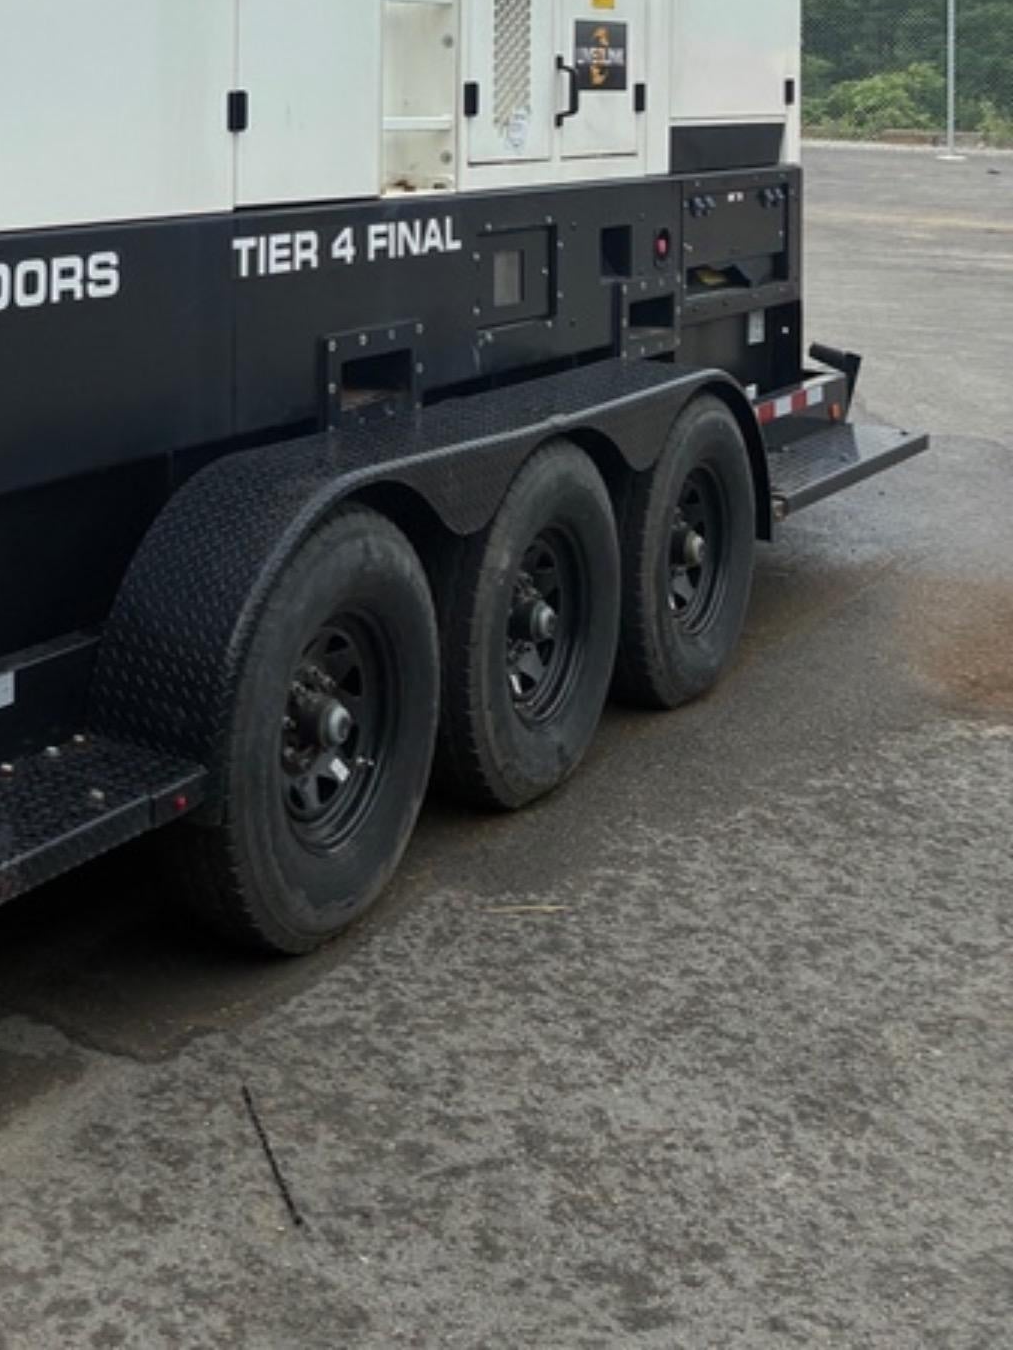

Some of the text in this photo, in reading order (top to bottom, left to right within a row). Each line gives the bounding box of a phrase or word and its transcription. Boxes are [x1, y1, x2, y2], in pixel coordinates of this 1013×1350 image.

[232, 215, 463, 278] TIER 4 FINAL
